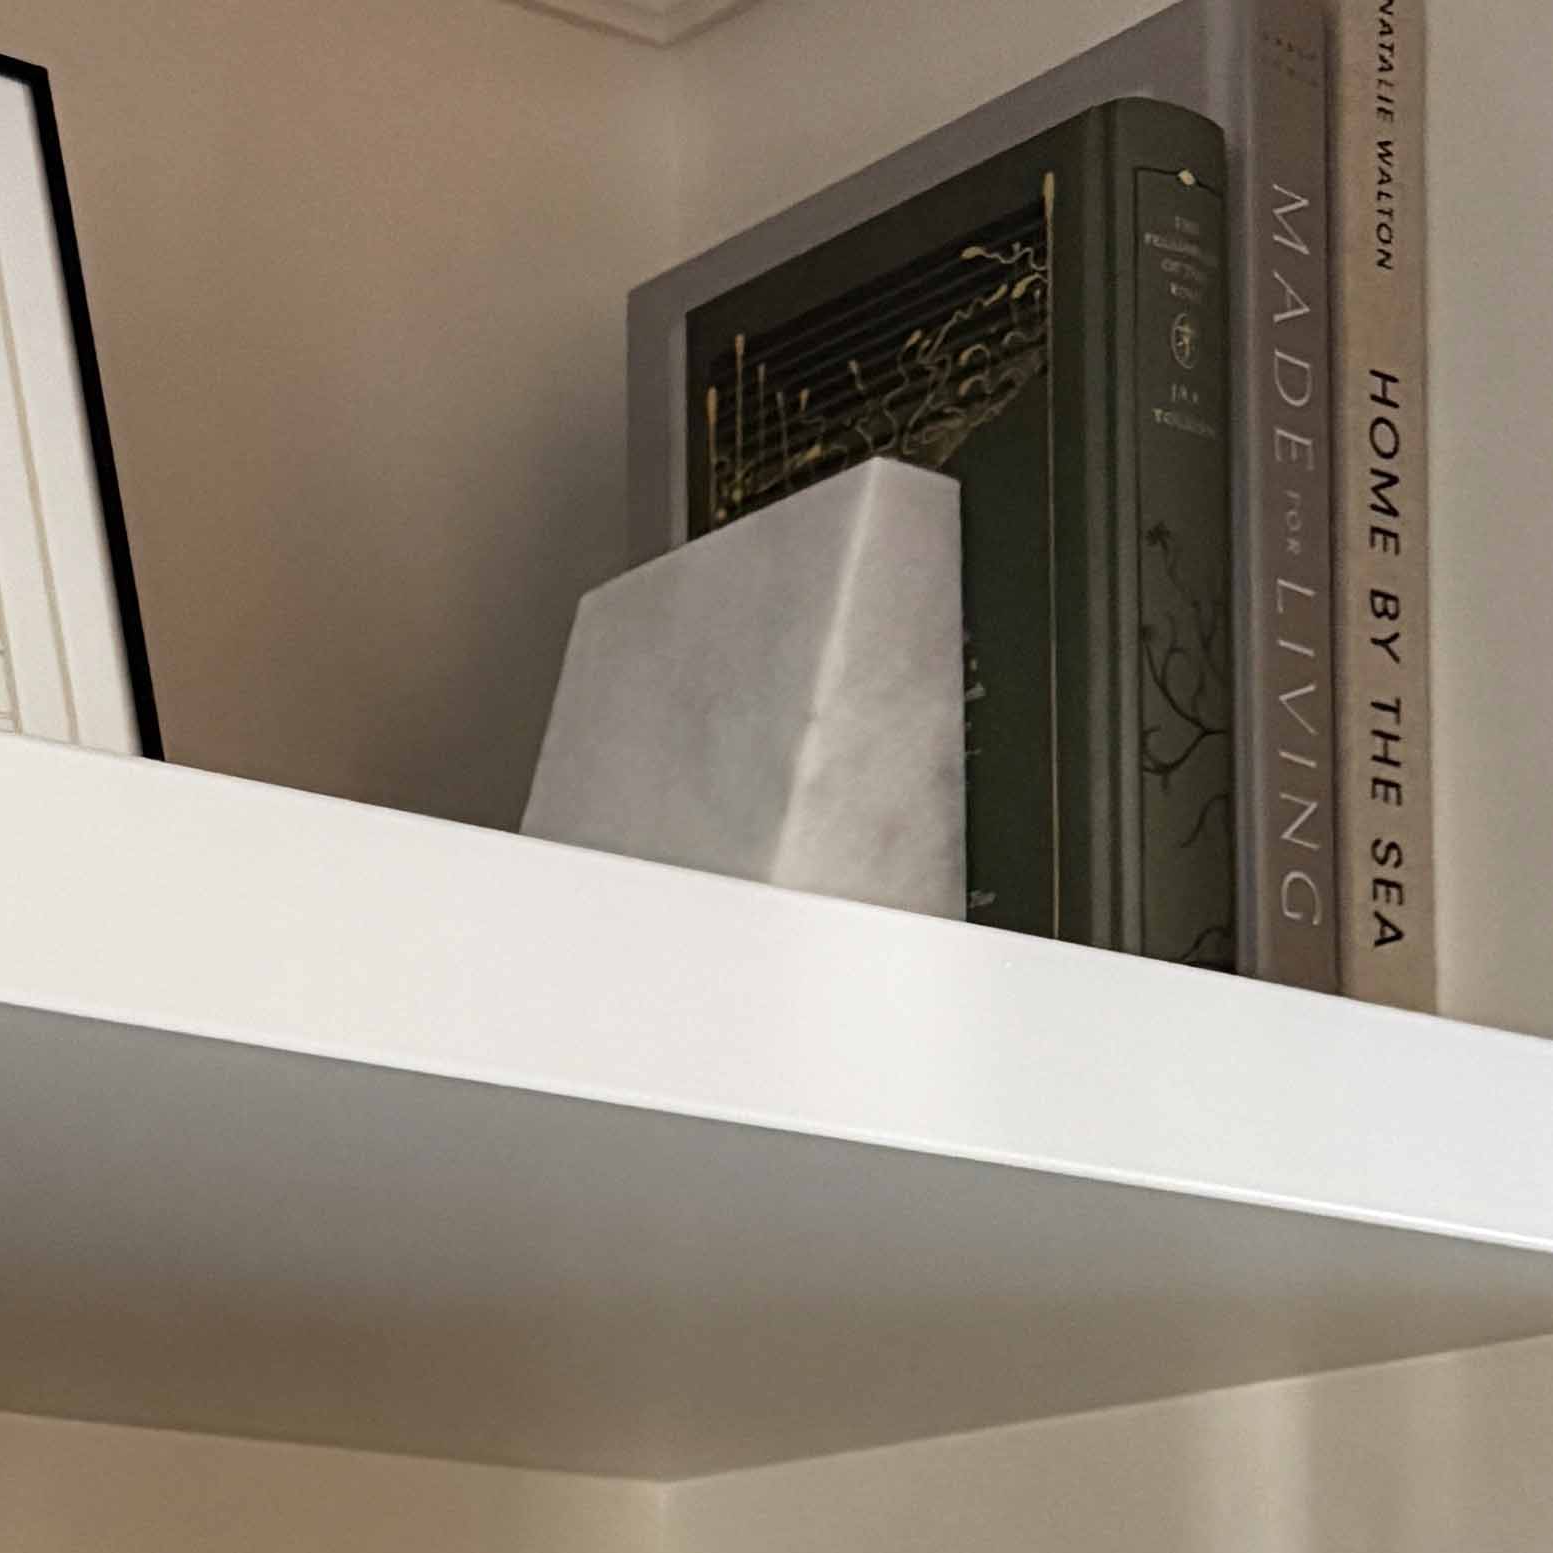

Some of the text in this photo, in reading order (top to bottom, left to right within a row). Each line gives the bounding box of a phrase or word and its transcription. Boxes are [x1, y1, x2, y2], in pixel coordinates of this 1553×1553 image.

[1376, 0, 1396, 270] NATALIE WALTON
[1272, 184, 1314, 472] MADE
[1278, 578, 1322, 926] LIVING
[1369, 369, 1405, 948] HOME BY THE SEA
